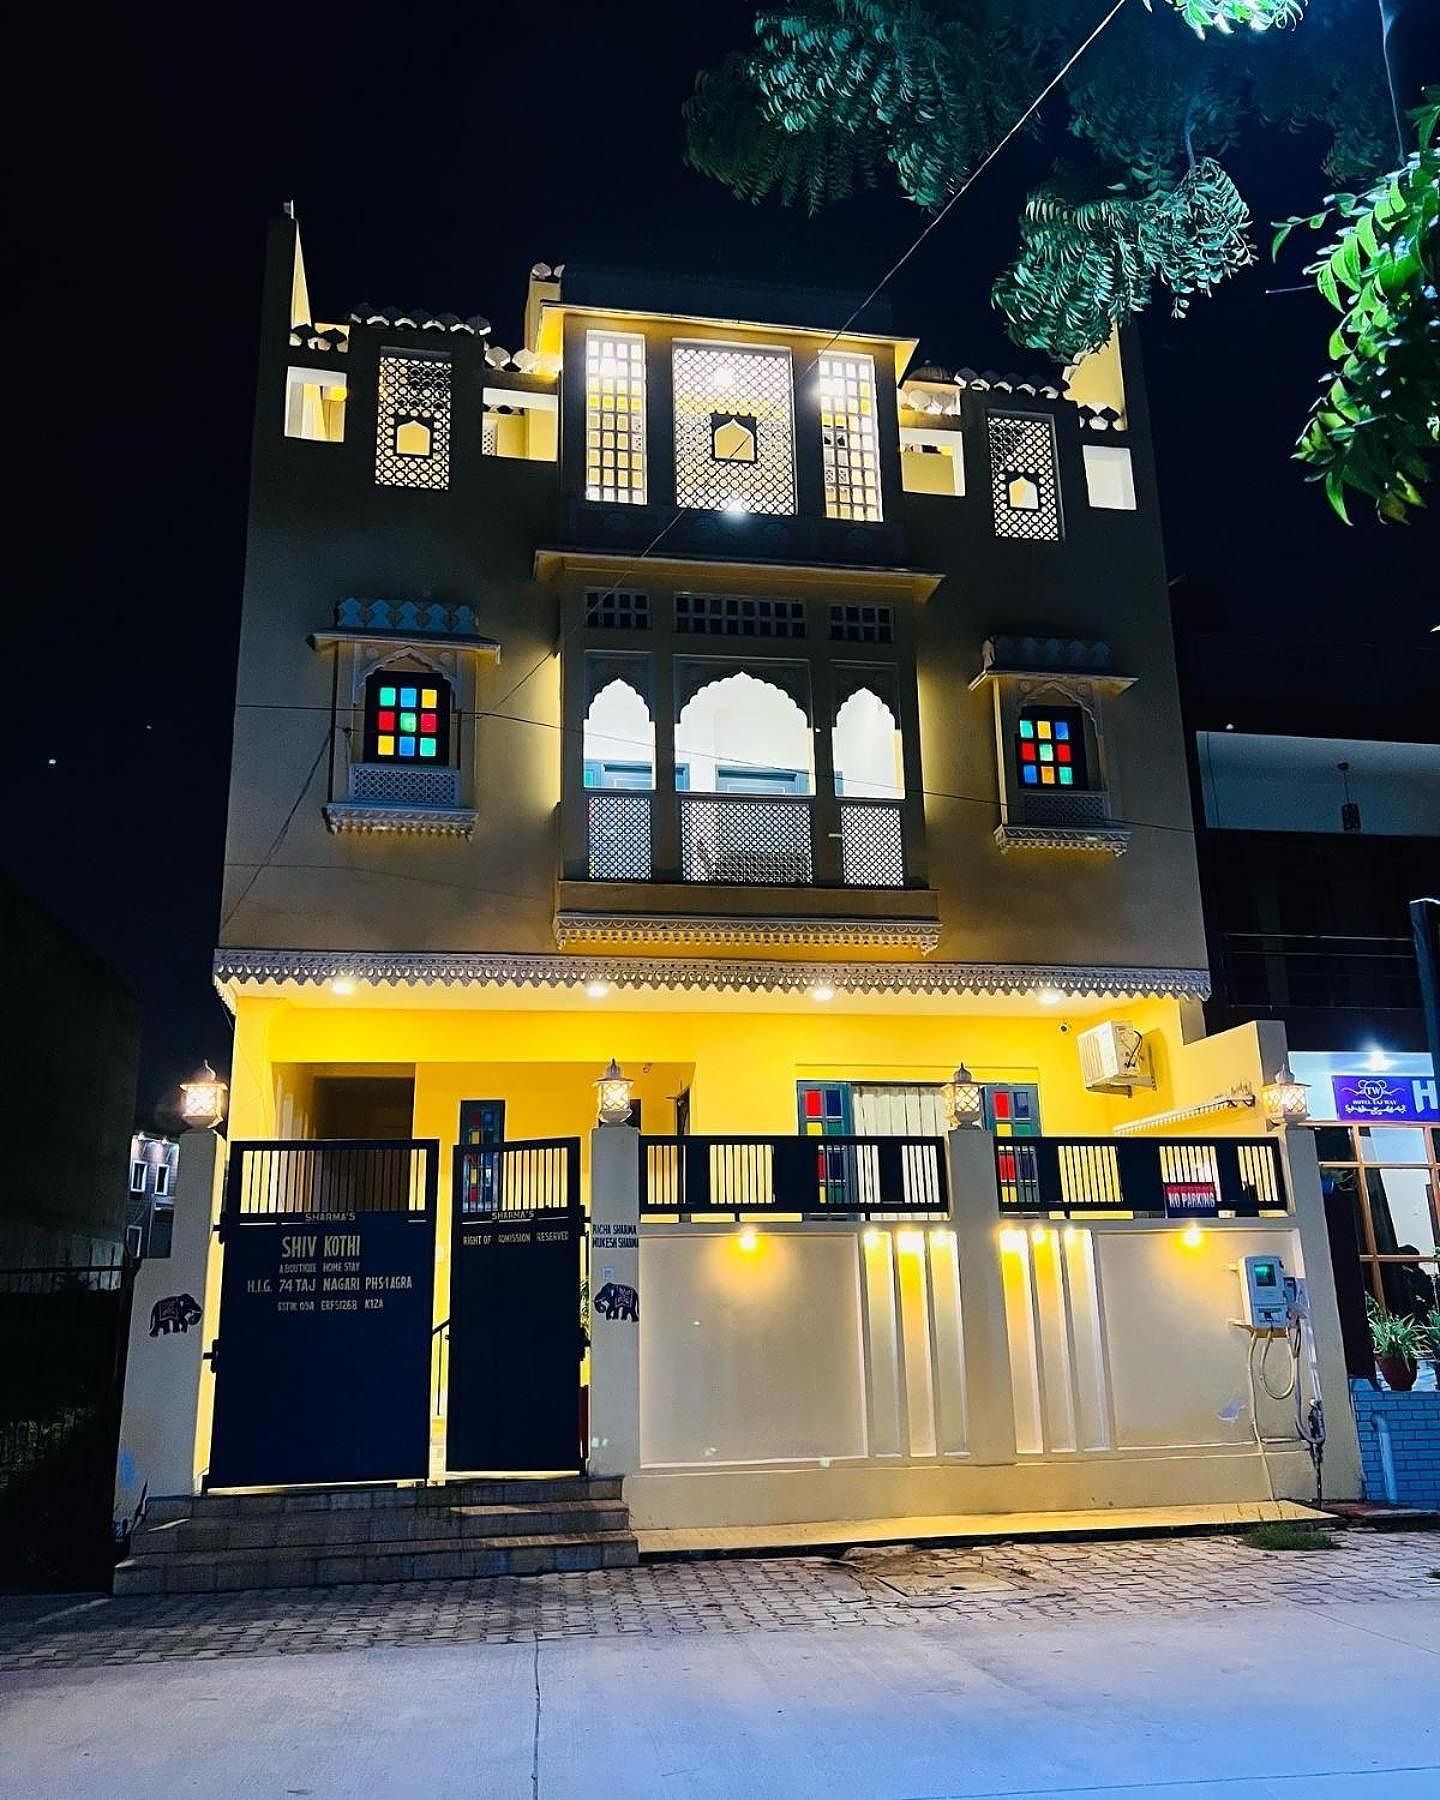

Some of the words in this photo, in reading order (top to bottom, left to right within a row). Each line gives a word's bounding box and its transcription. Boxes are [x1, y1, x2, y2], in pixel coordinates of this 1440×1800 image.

[1168, 1192, 1181, 1208] NO
[1181, 1191, 1215, 1208] PARKING
[305, 1212, 356, 1221] SHARMA'S
[491, 1210, 535, 1220] SHARMA'S
[463, 1235, 482, 1245] RIGHT
[483, 1235, 492, 1245] OF
[281, 1235, 318, 1258] SHIV
[323, 1235, 361, 1257] KOTHI
[323, 1262, 342, 1272] HOME
[343, 1262, 361, 1272] STAY
[279, 1278, 293, 1292] 74
[295, 1278, 316, 1292] TAJ
[323, 1277, 360, 1291] NAGARI
[390, 1275, 413, 1290] AGRA
